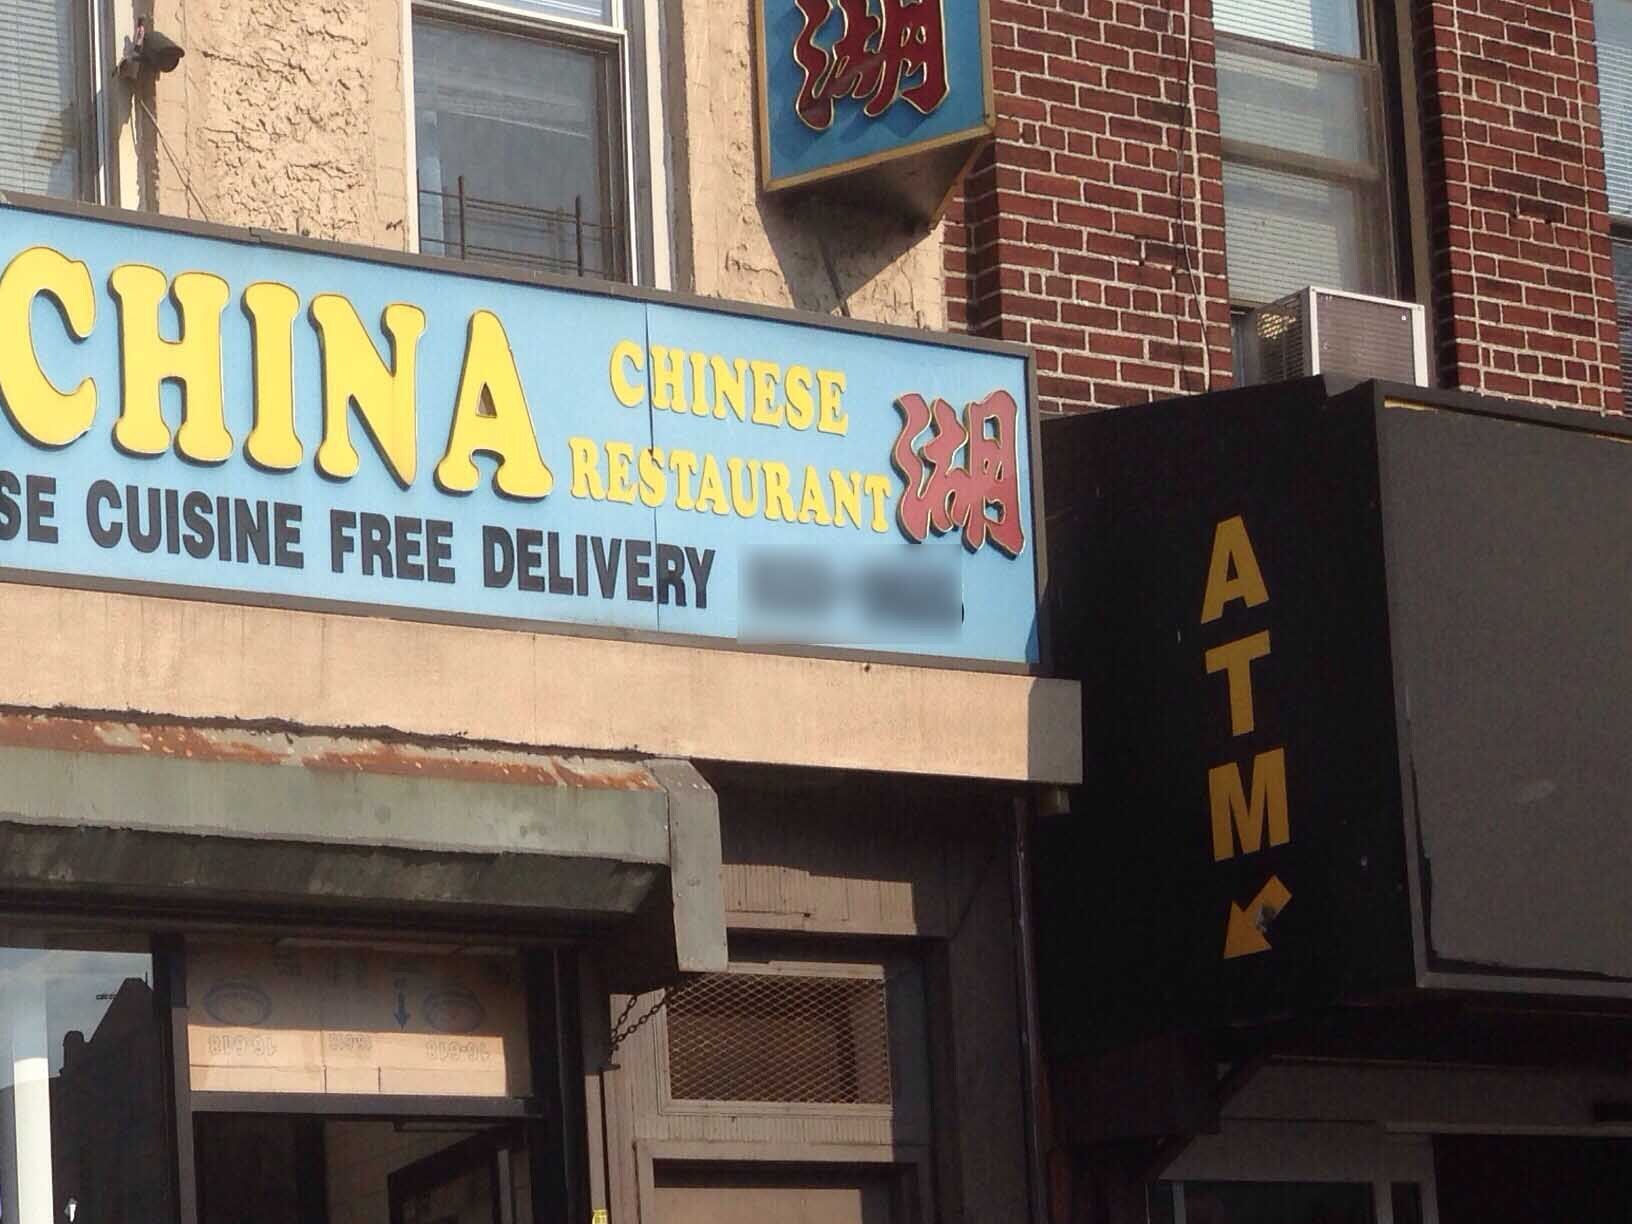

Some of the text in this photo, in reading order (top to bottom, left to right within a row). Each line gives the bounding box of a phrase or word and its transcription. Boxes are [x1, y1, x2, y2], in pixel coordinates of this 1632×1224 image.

[609, 339, 849, 437] CHINESE
[569, 436, 892, 535] RESTAURANT
[86, 479, 304, 570] CUISINE
[330, 509, 457, 584] FREE
[482, 525, 716, 610] DELIVERY
[1201, 515, 1290, 862] ATM
